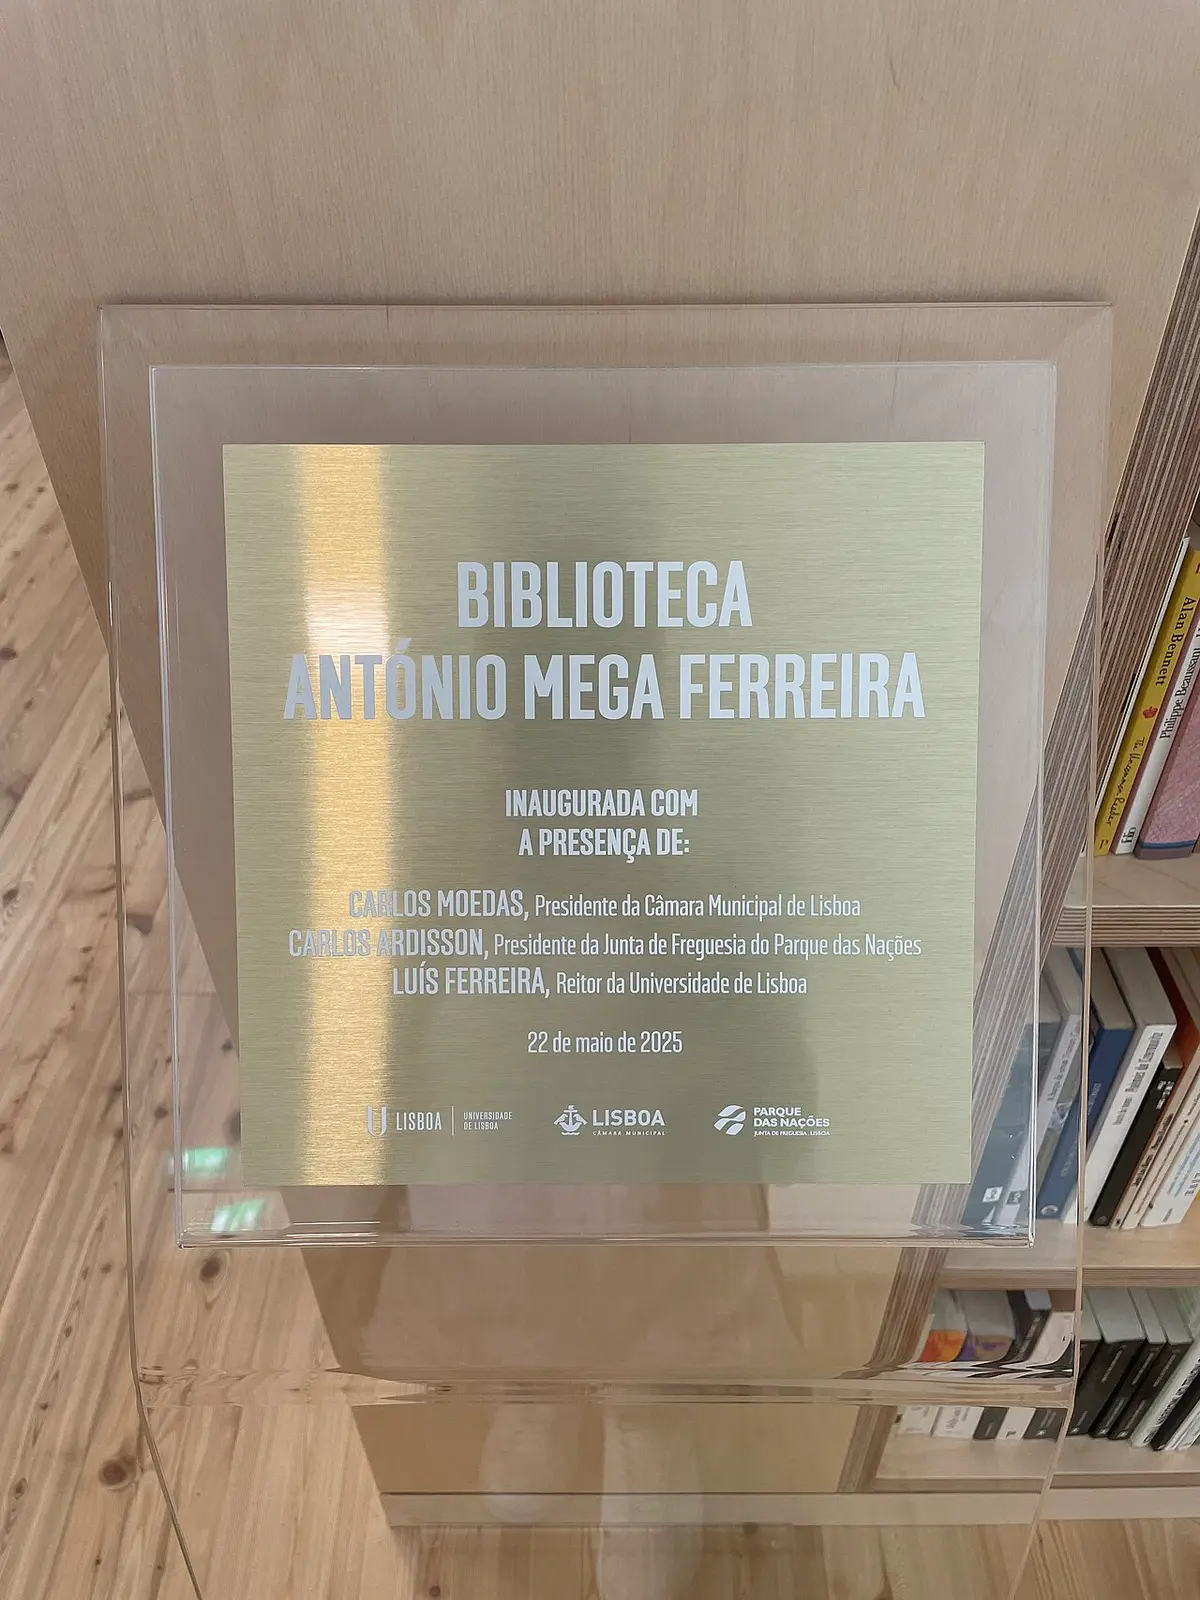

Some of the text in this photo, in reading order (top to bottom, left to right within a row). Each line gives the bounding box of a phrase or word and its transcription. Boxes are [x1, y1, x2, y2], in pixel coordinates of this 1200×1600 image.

[457, 560, 752, 628] BIBLIOTECA
[1155, 596, 1196, 686] Alan Bennett
[284, 638, 925, 722] ANTÓNIO MEGA FERREIRA
[1159, 698, 1185, 739] Philippe
[506, 788, 698, 818] INAUGURADA COM
[518, 828, 690, 863] A PRESENÇA DE:
[349, 888, 861, 922] CARLOS MOEDAS, Presidente da Câmara Municipal de Lisboa
[289, 929, 922, 962] CARLOS ARDISSON, Presidente da Junta de Freguesia do Parque das Nações
[393, 962, 808, 999] LUÍS FERREIRA, Reitor da Universidade de Lisboa
[528, 1031, 683, 1052] 22 de maio de 2025
[396, 1112, 442, 1131] LISBOA
[464, 1112, 512, 1120] UNIVERSIDADE
[464, 1122, 499, 1130] DE LISBOA
[592, 1109, 666, 1127] LISBOA
[753, 1107, 801, 1117] PARQUE
[753, 1116, 830, 1129] DAS NAÇÕES
